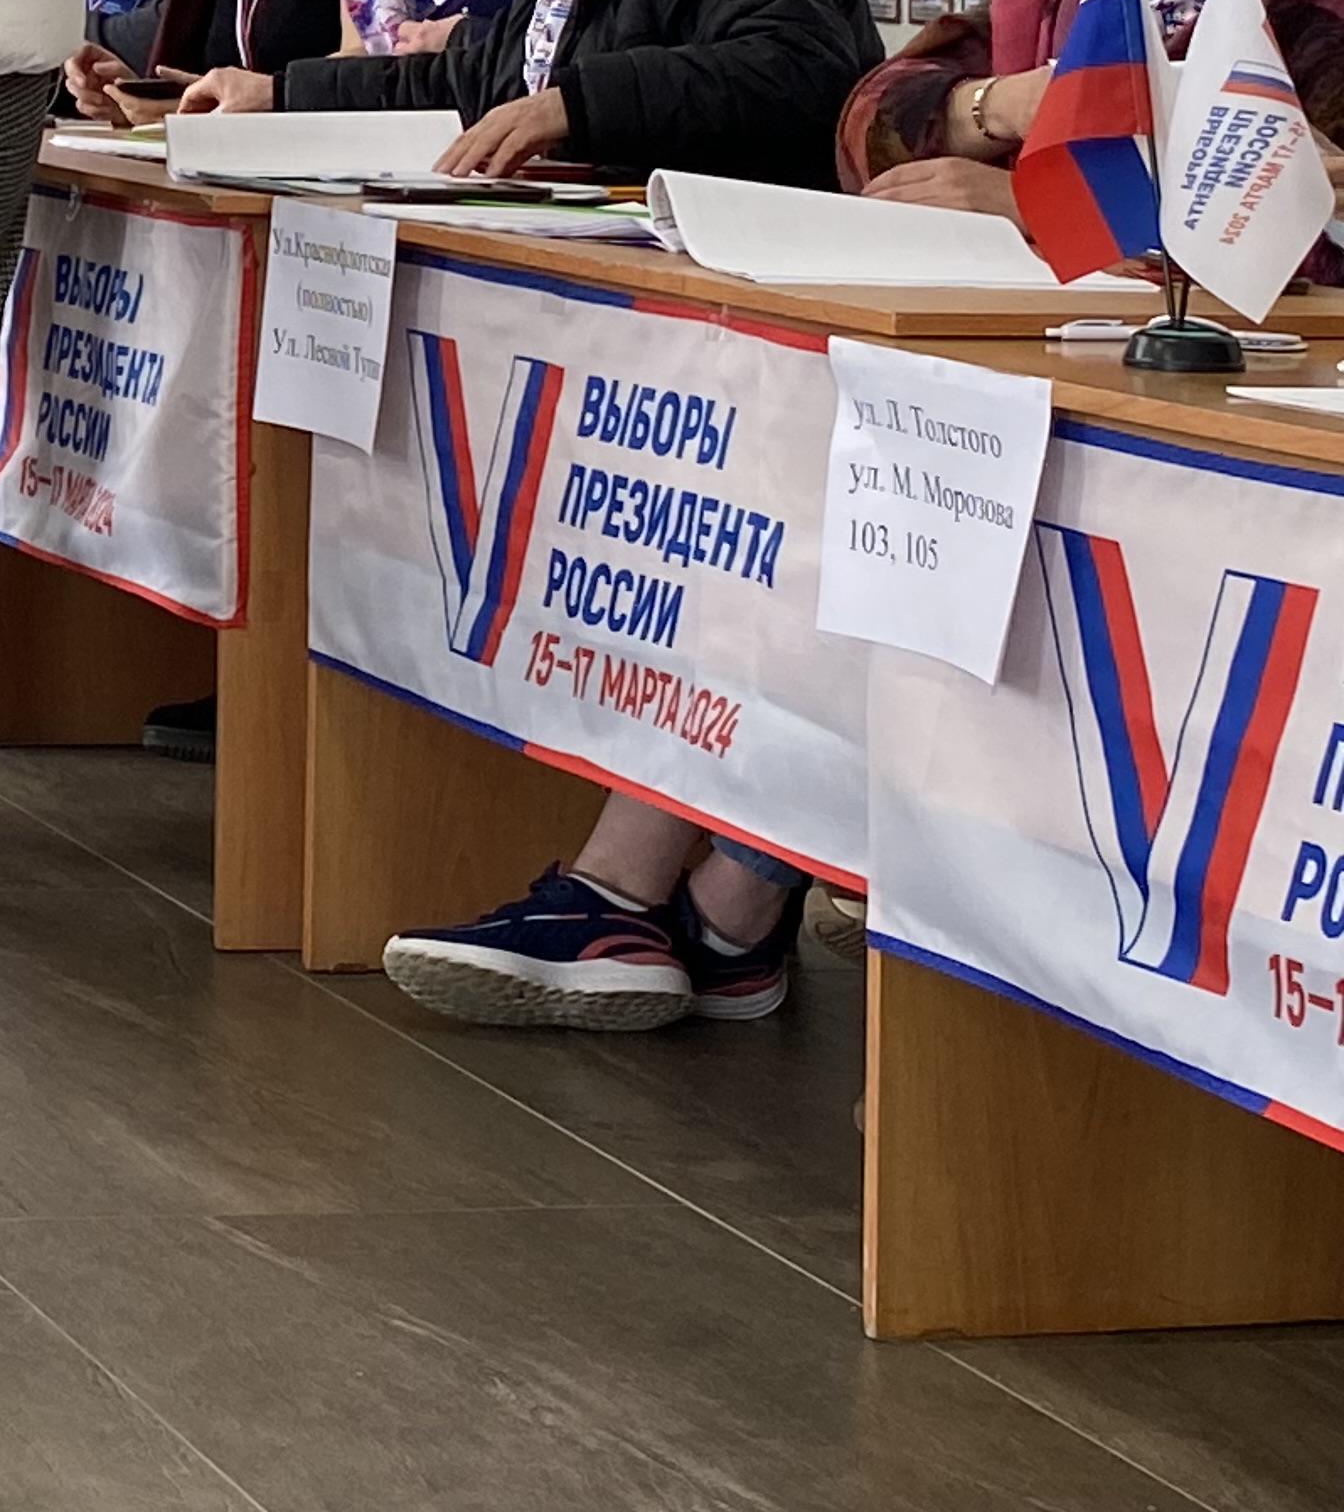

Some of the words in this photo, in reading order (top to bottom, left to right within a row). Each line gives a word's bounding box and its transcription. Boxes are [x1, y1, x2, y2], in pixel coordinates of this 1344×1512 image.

[54, 254, 144, 324] ВЫБОРЫ
[272, 328, 299, 358] Ул.
[35, 391, 112, 463] РОССИИ
[576, 374, 737, 470] ВЫБОРЫ
[852, 396, 883, 430] ул.
[886, 399, 908, 435] Л.
[908, 405, 1003, 459] Толстого
[559, 462, 785, 589] ПРЕЗИДЕНТА
[848, 462, 885, 495] ул.
[892, 462, 918, 501] М.
[921, 471, 1015, 530] Морозова
[849, 518, 896, 566] 103,
[905, 531, 939, 571] 105
[543, 547, 685, 648] РОССИИ
[598, 653, 683, 733] МАРТА
[681, 681, 742, 759] 2024
